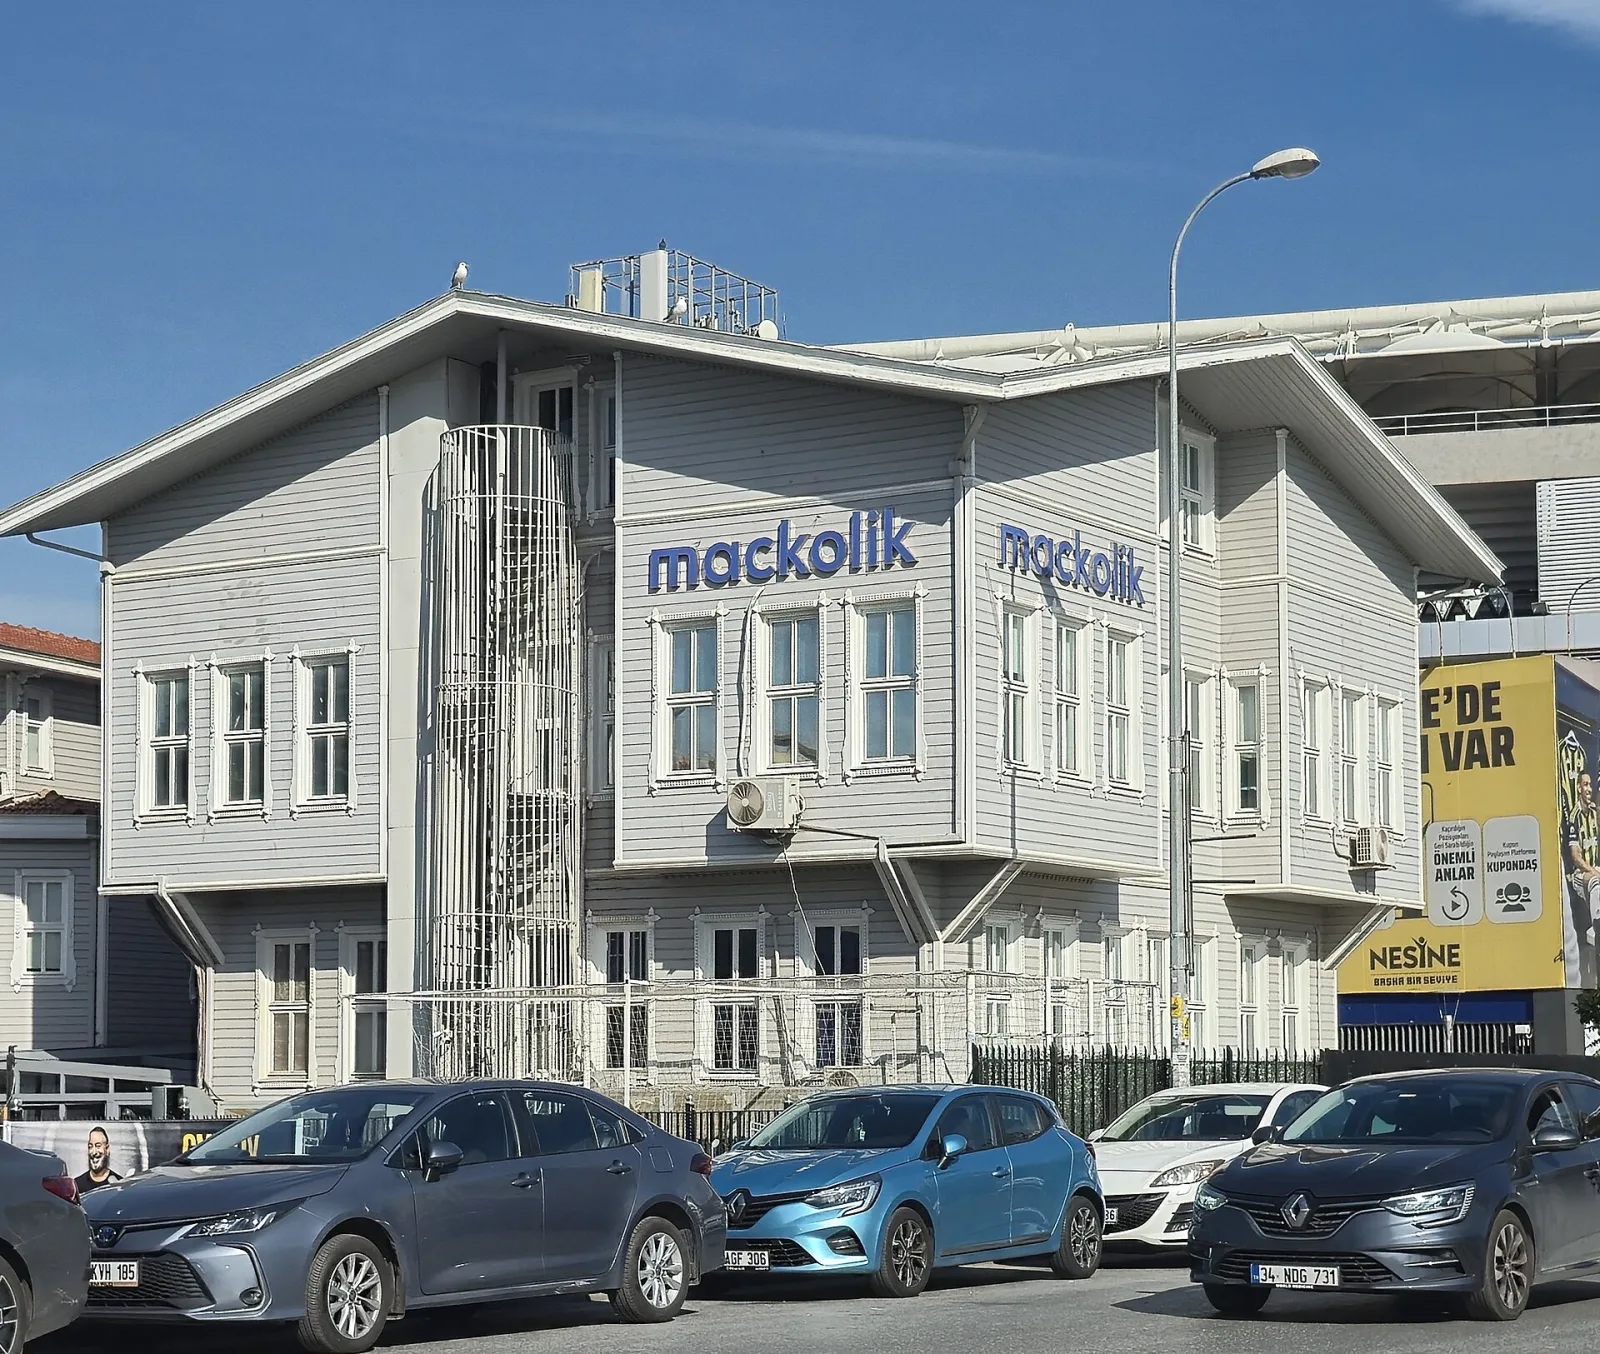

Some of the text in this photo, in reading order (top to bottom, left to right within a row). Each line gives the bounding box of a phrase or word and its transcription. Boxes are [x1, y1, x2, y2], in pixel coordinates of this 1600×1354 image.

[649, 507, 918, 592] mackolik
[998, 522, 1146, 606] mackolik
[1439, 726, 1516, 772] VAR
[1434, 847, 1475, 866] ÖNEMLİ
[1486, 858, 1538, 873] KUPONDAŞ
[1435, 866, 1475, 882] ANLAR
[725, 1252, 767, 1265] AGF 306
[117, 1263, 135, 1281] 185
[1260, 1267, 1275, 1282] 34
[1284, 1268, 1307, 1283] NDG
[1314, 1269, 1336, 1284] 731
